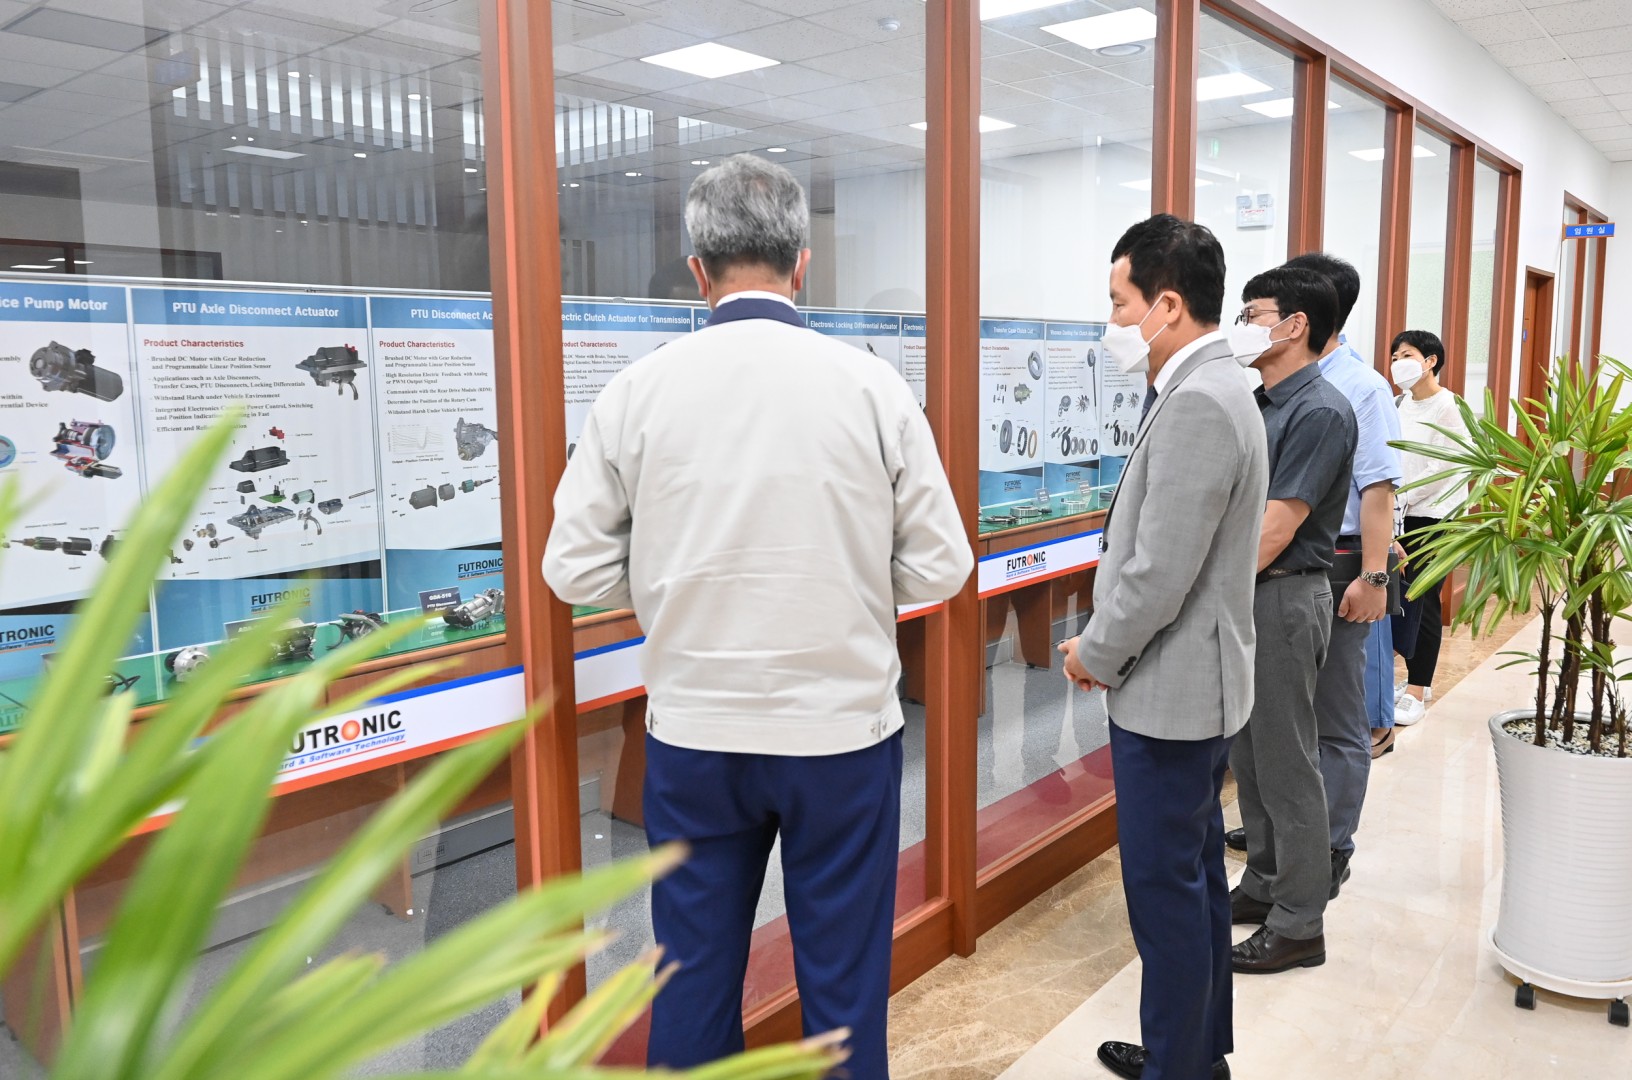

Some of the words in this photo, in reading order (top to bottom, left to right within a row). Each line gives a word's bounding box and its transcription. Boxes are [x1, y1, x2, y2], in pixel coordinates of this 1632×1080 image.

[0, 297, 19, 308] ice
[24, 298, 64, 311] Pump
[68, 298, 107, 310] Motor
[173, 302, 196, 313] PTU
[200, 304, 225, 314] Axle
[229, 304, 292, 315] Disconnect
[295, 306, 338, 316] Actuator
[411, 309, 428, 318] PTU
[432, 310, 480, 320] Disconnect
[584, 313, 606, 322] Clutch
[608, 314, 636, 323] Actuator
[639, 315, 648, 323] for
[650, 315, 690, 324] Transmission
[836, 321, 853, 330] Locking
[458, 558, 503, 572] FUTRONIC
[1007, 551, 1046, 571] FUTRONIC
[251, 588, 310, 605] FUTRONIC
[0, 625, 54, 643] TRONIC
[288, 710, 402, 754] UTRONIC
[309, 748, 351, 762] Software
[355, 733, 405, 750] Technology
